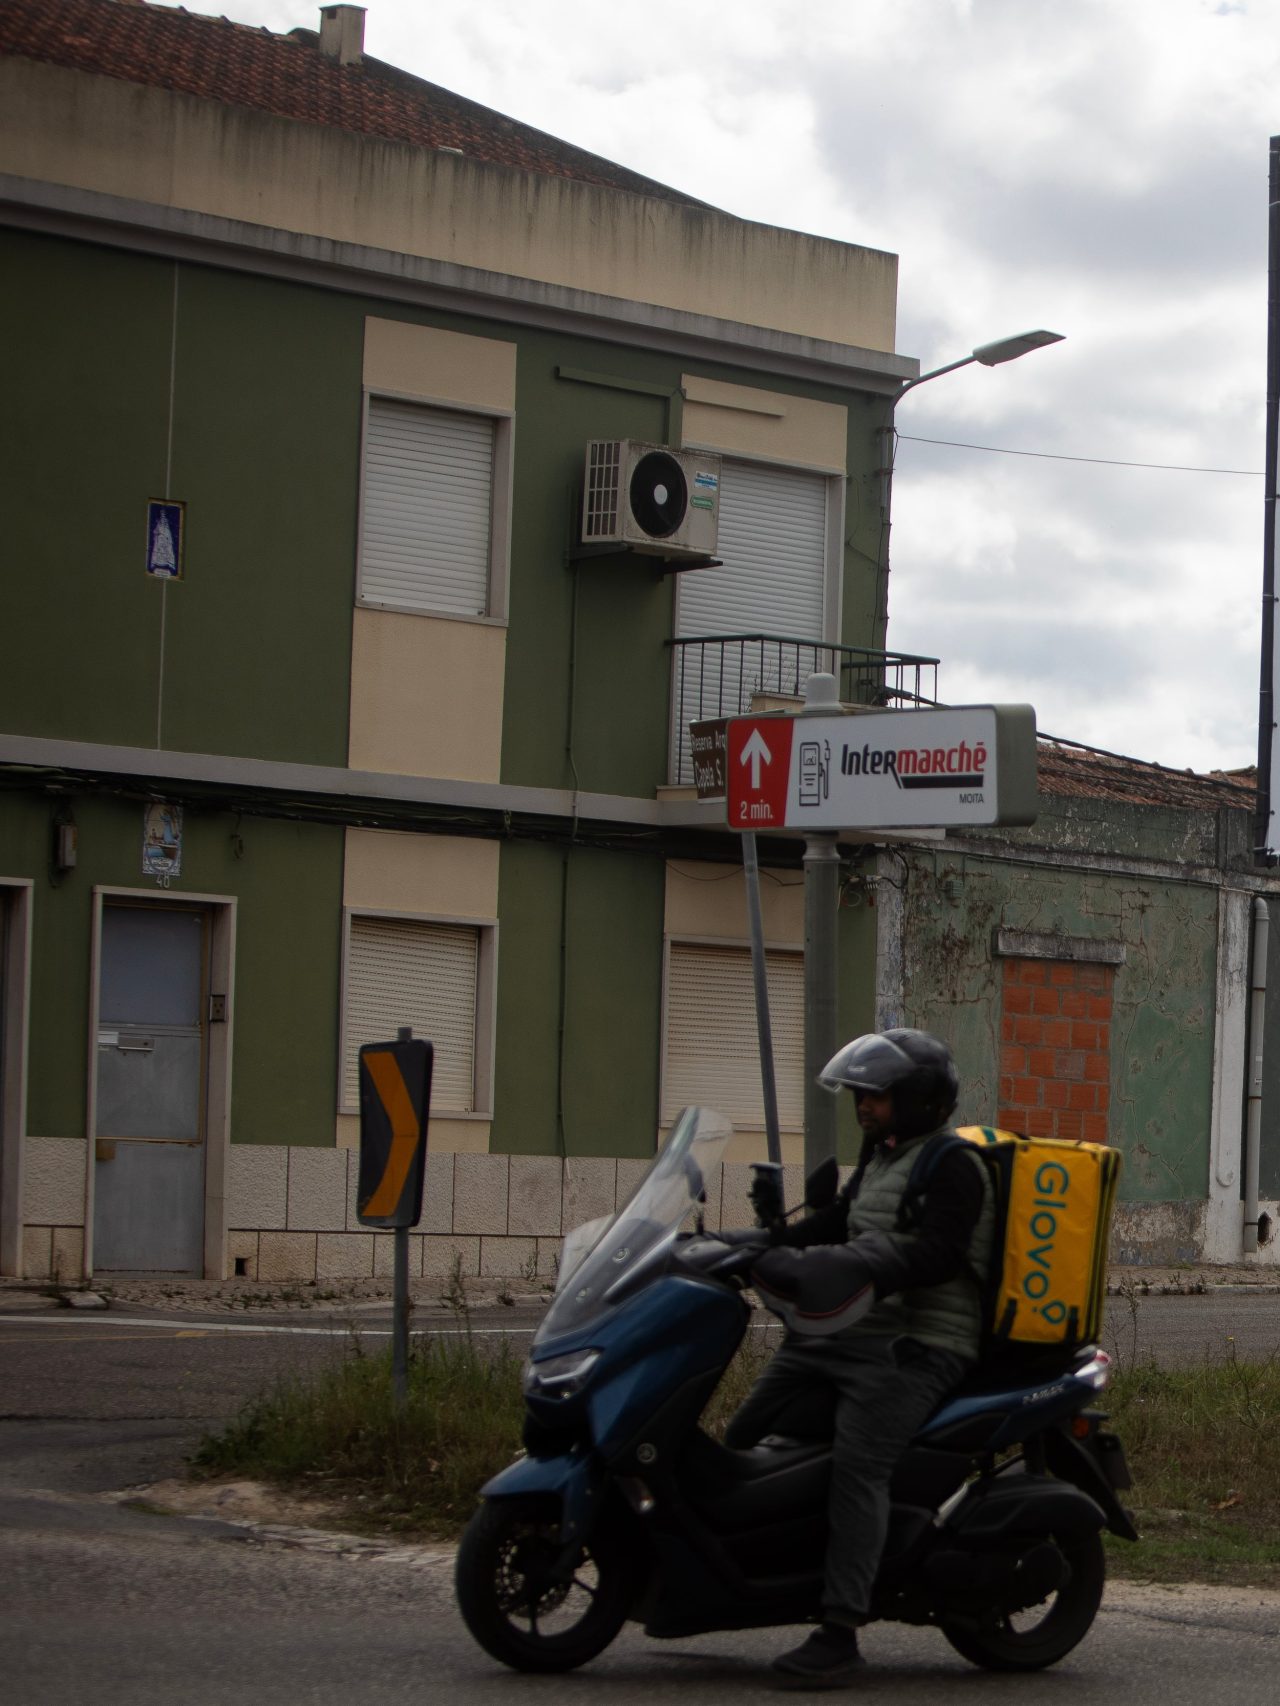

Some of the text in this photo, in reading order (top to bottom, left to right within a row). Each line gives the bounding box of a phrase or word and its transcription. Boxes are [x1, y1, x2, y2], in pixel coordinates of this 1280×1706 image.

[841, 740, 987, 790] Intermarché
[740, 801, 774, 820] 2 min.
[959, 793, 985, 804] MOITA
[1023, 1161, 1070, 1300] Glovo
